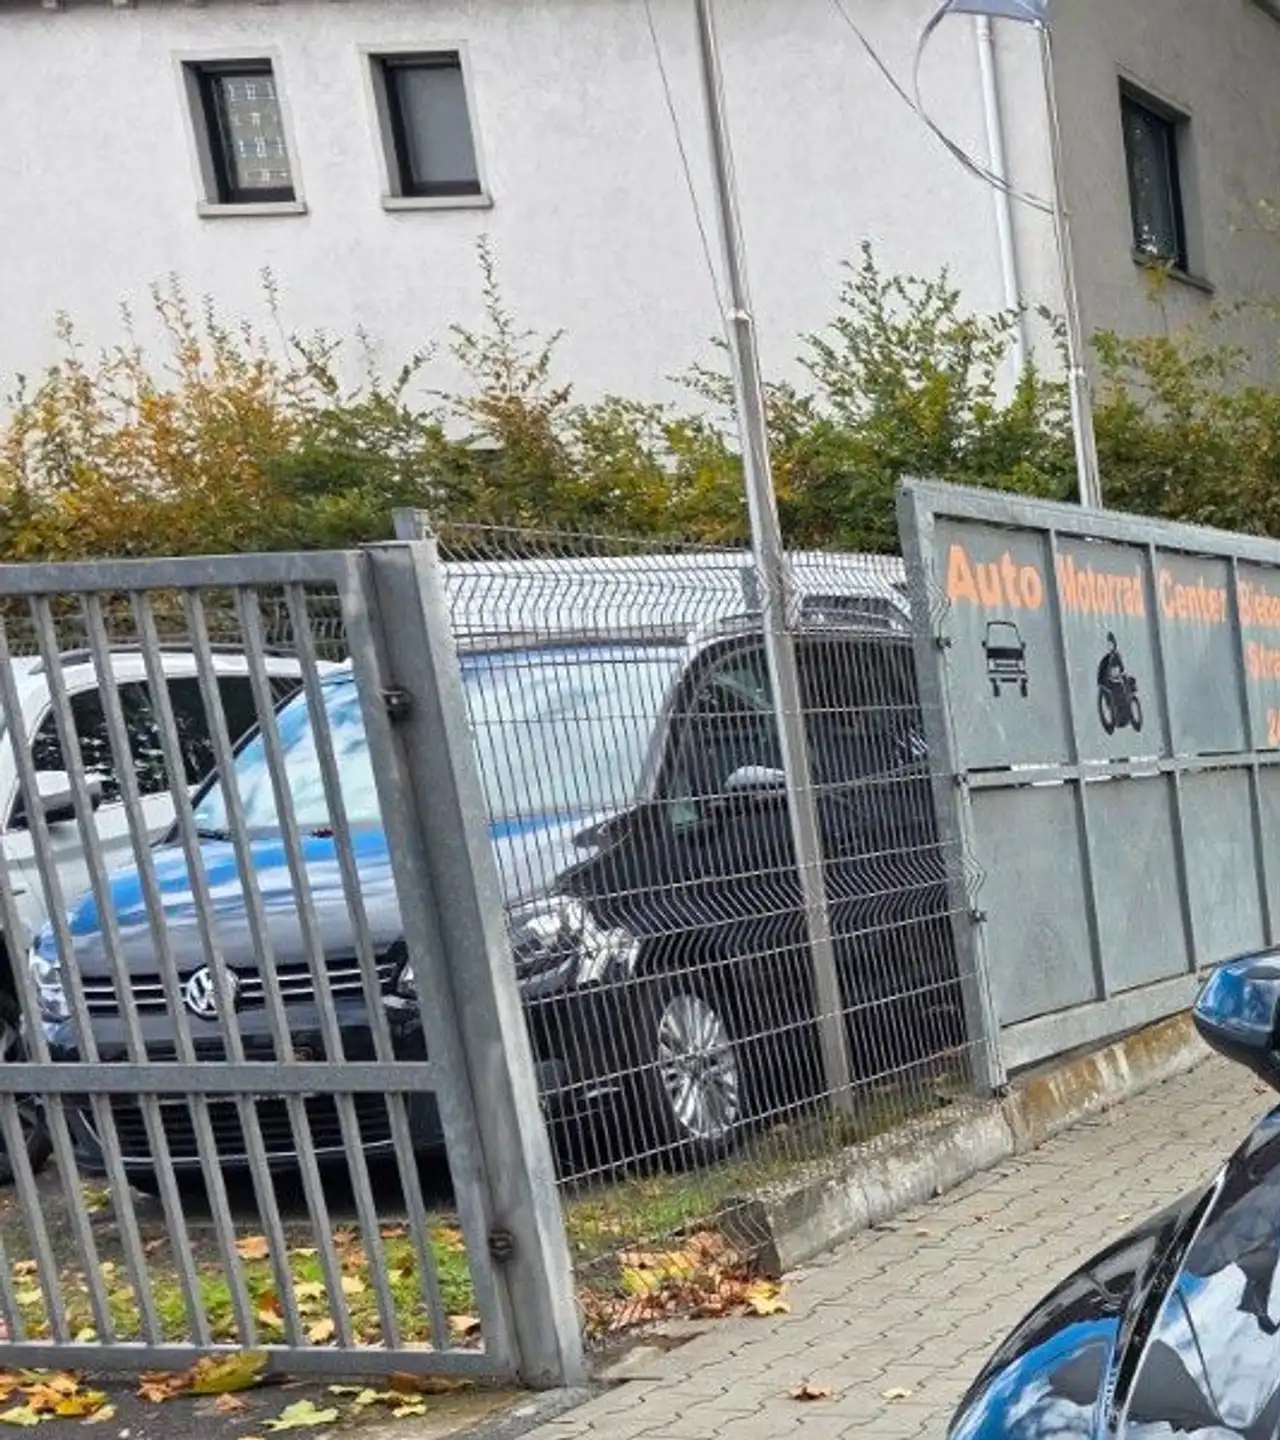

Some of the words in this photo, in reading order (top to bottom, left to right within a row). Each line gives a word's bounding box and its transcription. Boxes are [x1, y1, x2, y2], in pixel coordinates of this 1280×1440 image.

[948, 544, 1043, 610] Auto
[1054, 553, 1146, 616] Motorrad
[1159, 568, 1227, 624] Center
